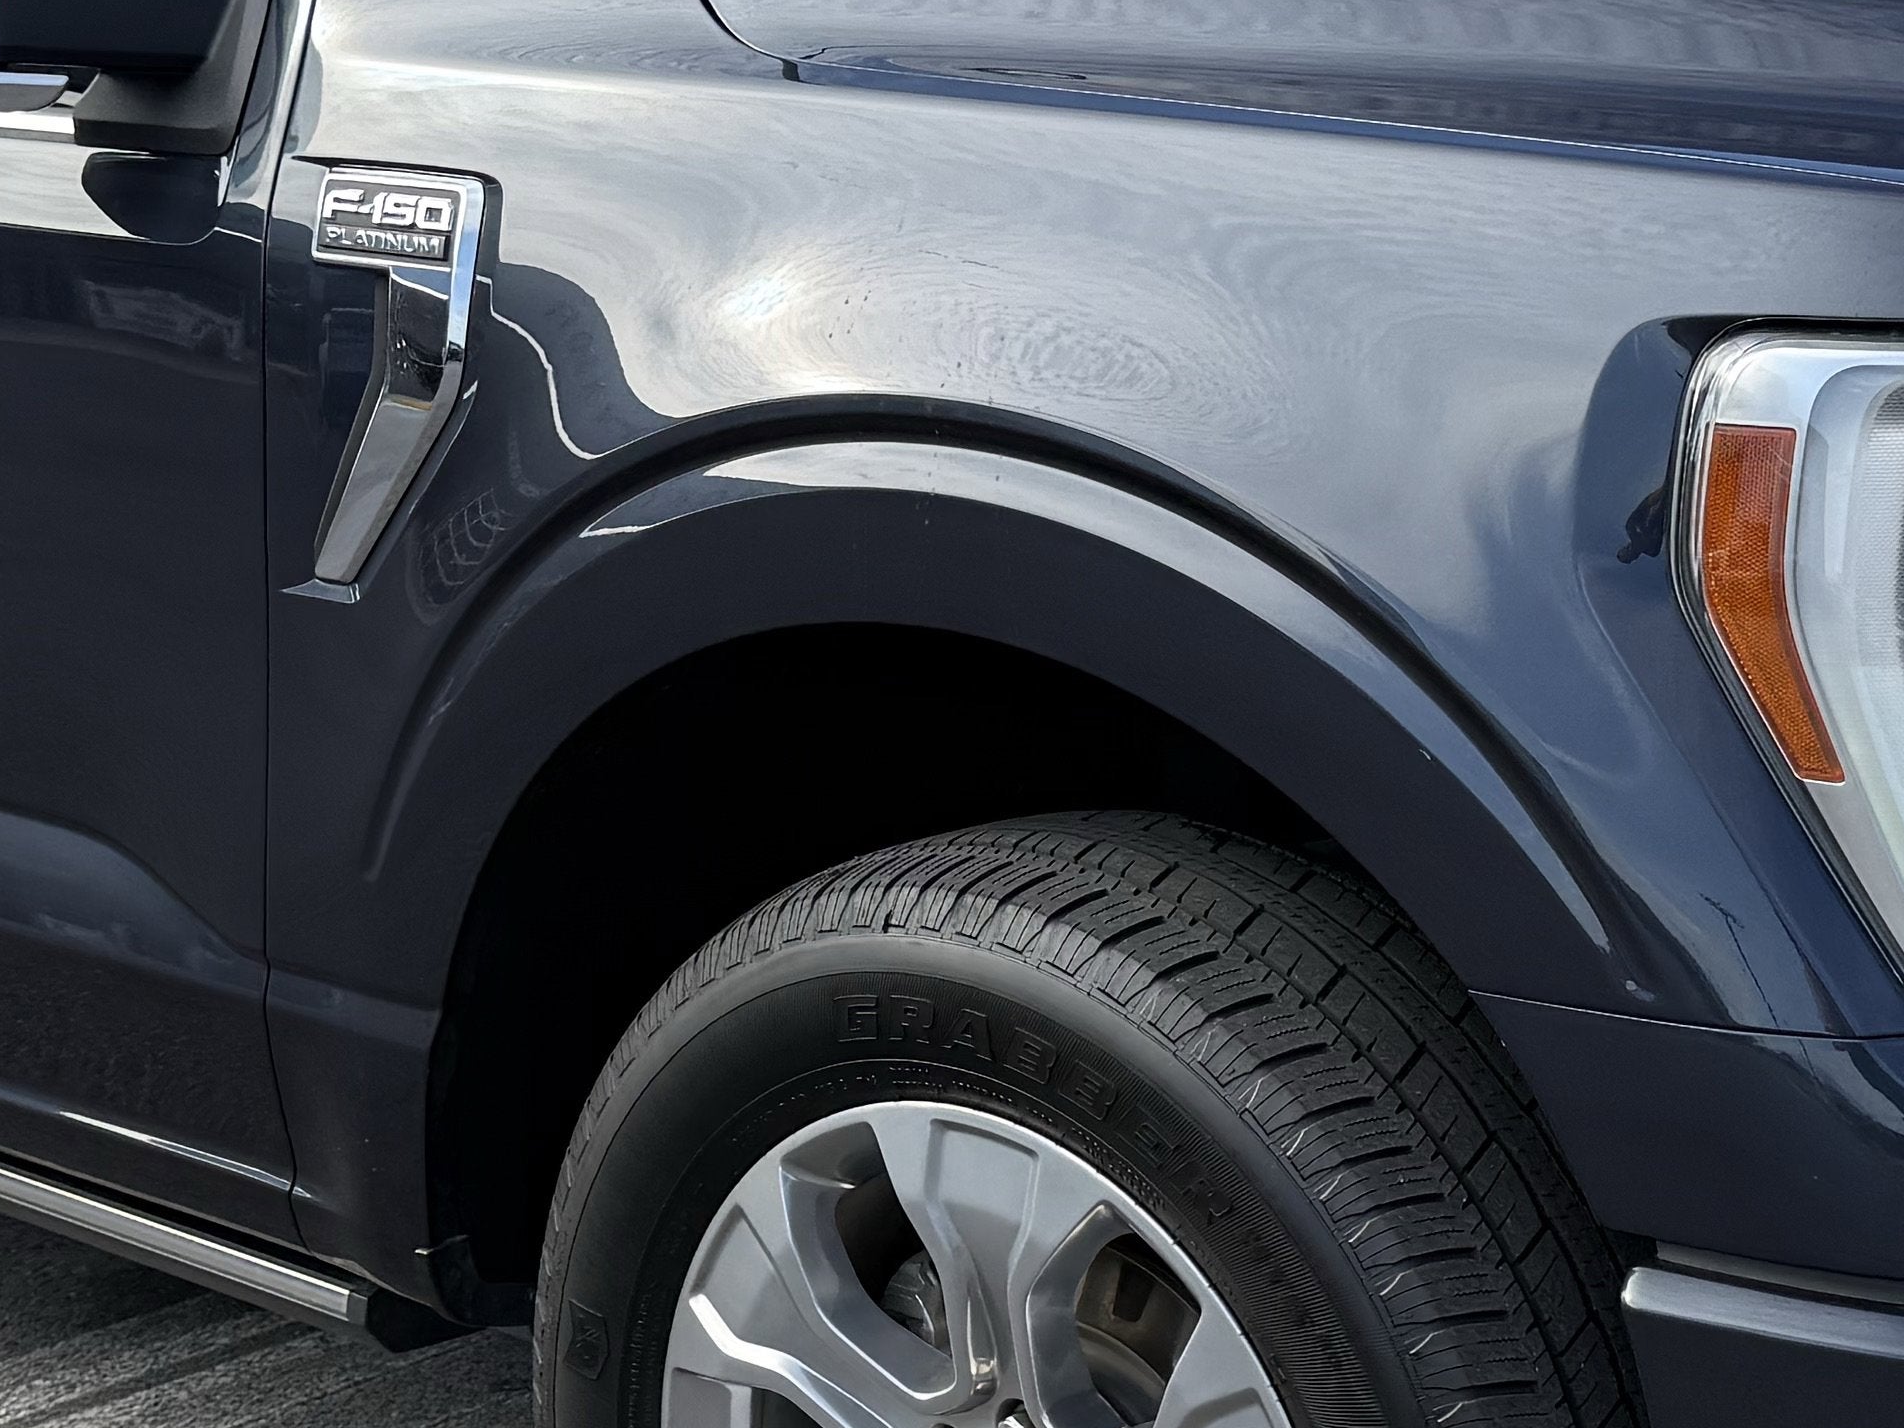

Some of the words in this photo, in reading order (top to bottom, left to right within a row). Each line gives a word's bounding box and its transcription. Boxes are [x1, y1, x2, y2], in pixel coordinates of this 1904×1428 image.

[321, 188, 454, 232] F-150
[325, 225, 441, 255] PLATINUM
[831, 993, 1234, 1218] GRABBER
